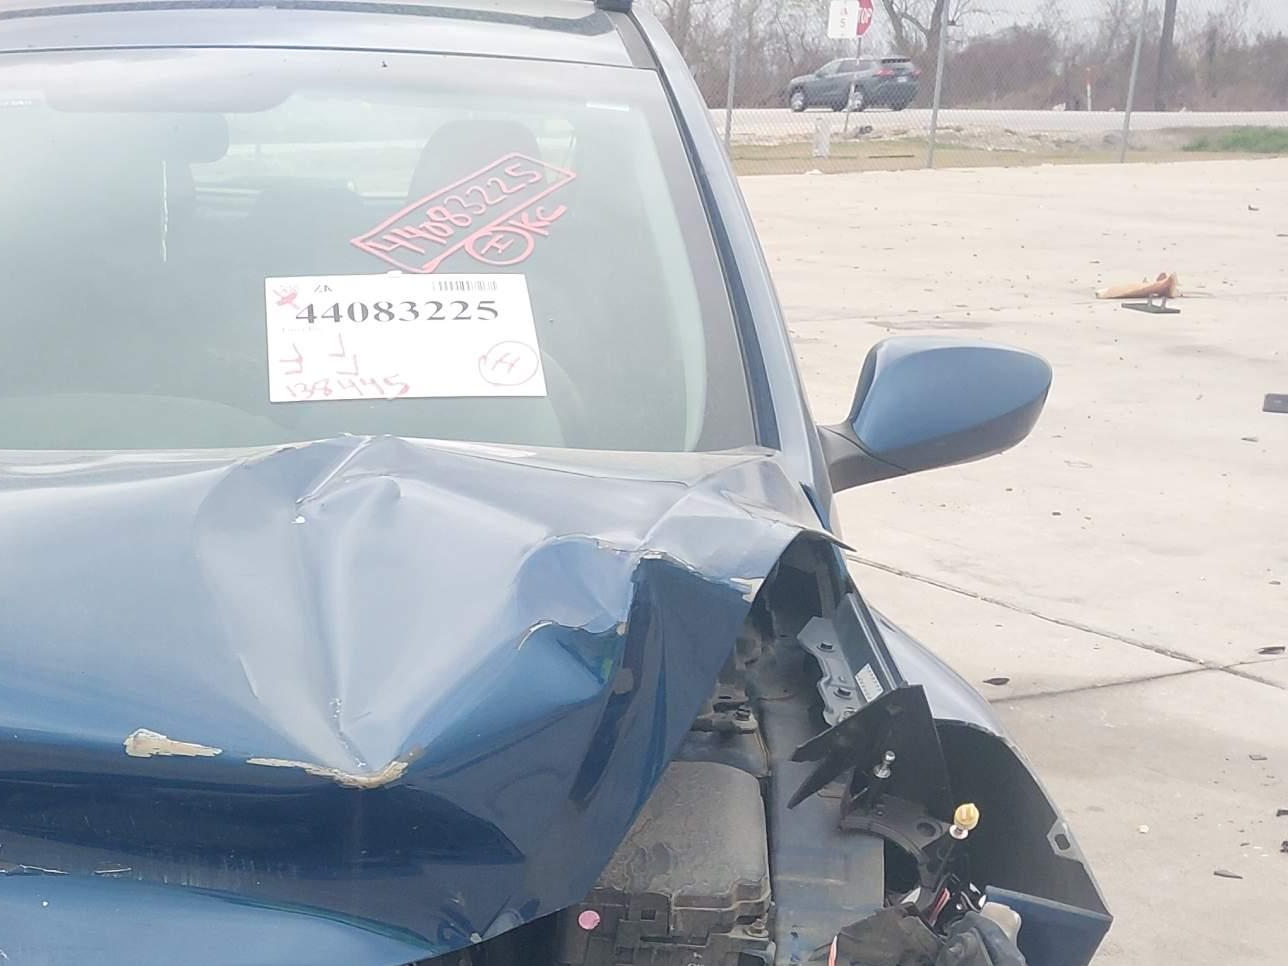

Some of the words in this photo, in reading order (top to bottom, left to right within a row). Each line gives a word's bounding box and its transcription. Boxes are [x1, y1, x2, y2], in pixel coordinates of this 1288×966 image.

[856, 7, 873, 25] TOP
[364, 162, 544, 255] 44083225
[295, 300, 499, 324] 44083225
